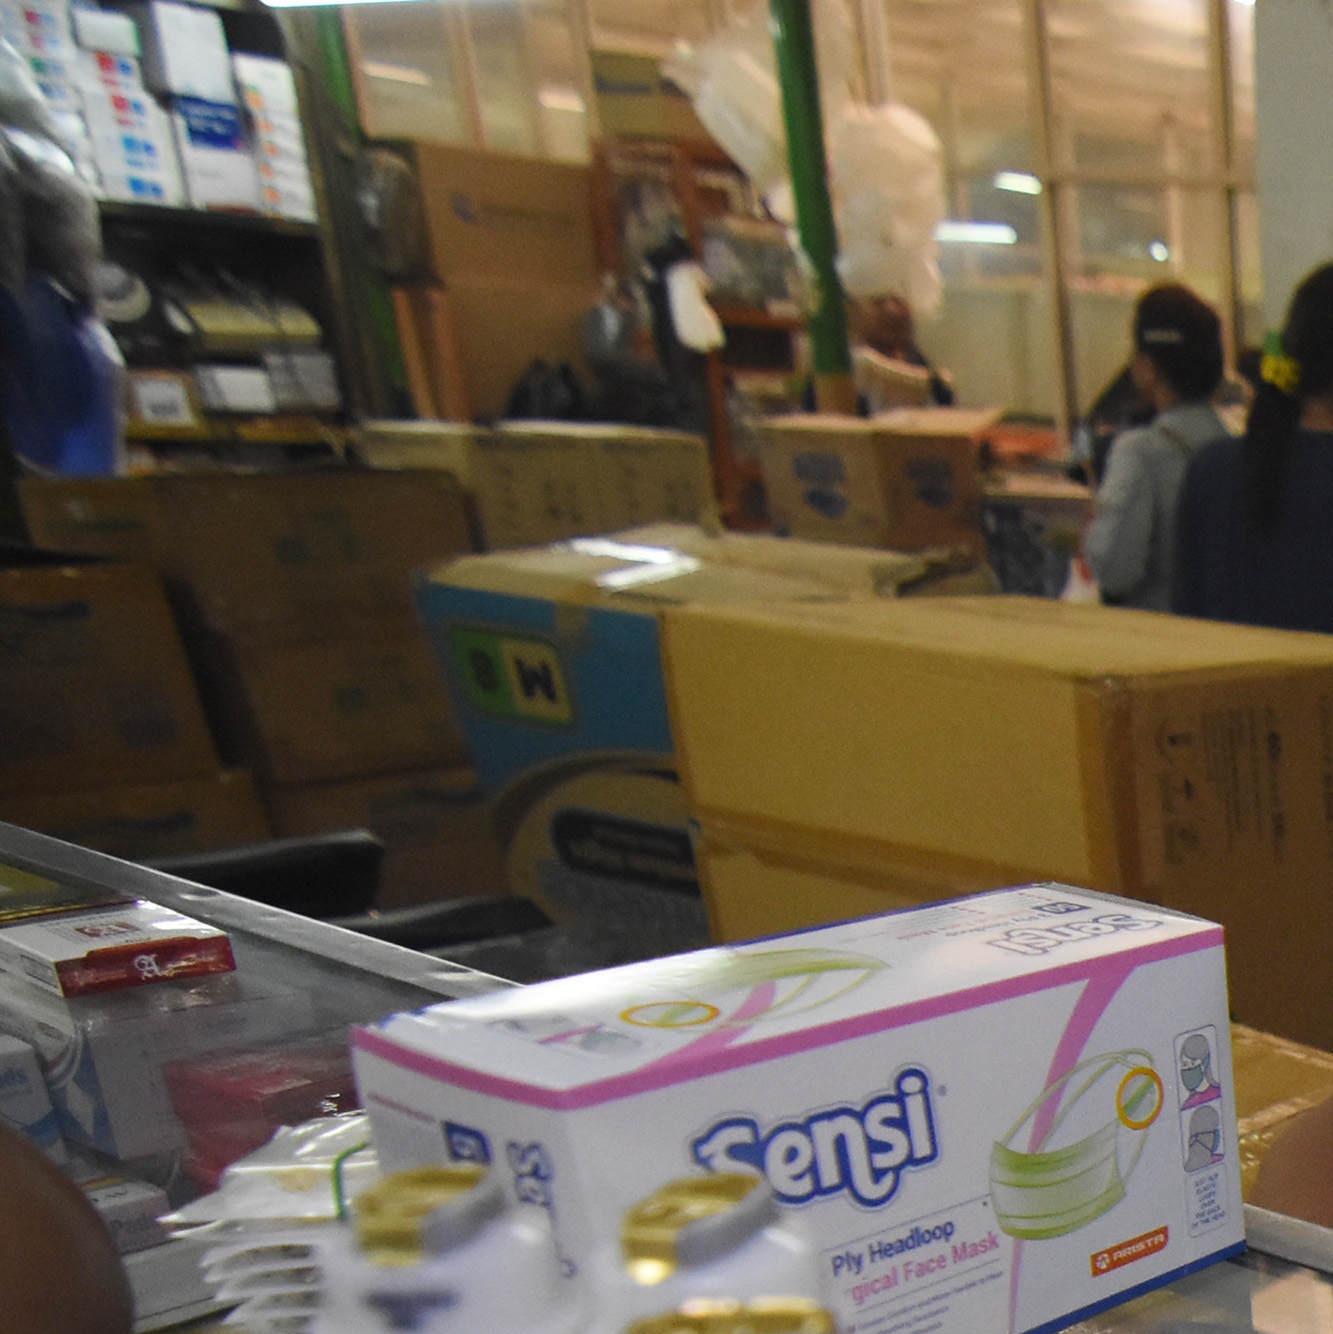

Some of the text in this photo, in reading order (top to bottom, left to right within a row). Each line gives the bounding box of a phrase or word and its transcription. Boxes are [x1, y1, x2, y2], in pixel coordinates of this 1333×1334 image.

[692, 1067, 938, 1207] Sensi
[832, 1221, 956, 1277] Ply Headloop
[846, 1231, 999, 1306] gical Face Mask
